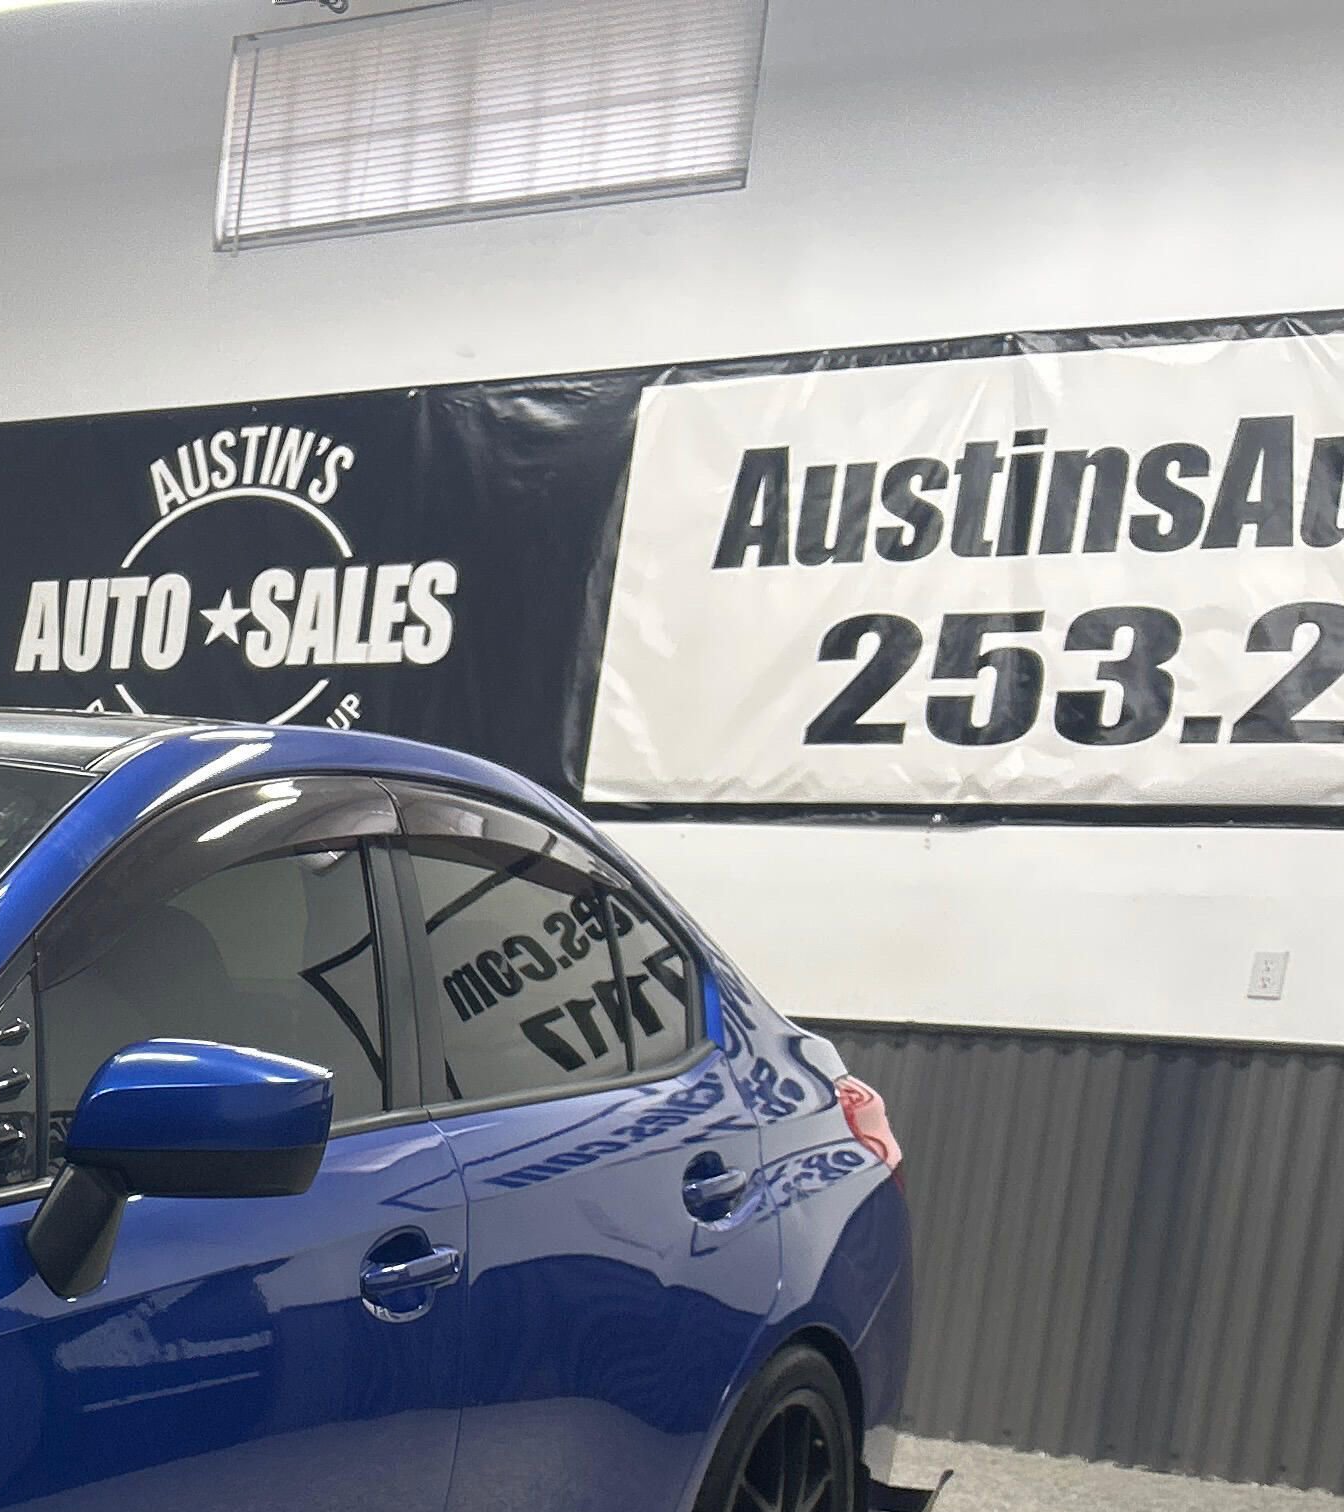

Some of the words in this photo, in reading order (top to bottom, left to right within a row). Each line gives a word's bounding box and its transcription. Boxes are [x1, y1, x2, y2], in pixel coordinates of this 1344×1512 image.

[149, 425, 355, 516] AUSTIN'S
[15, 572, 191, 673] AUTO
[245, 560, 458, 668] SALES
